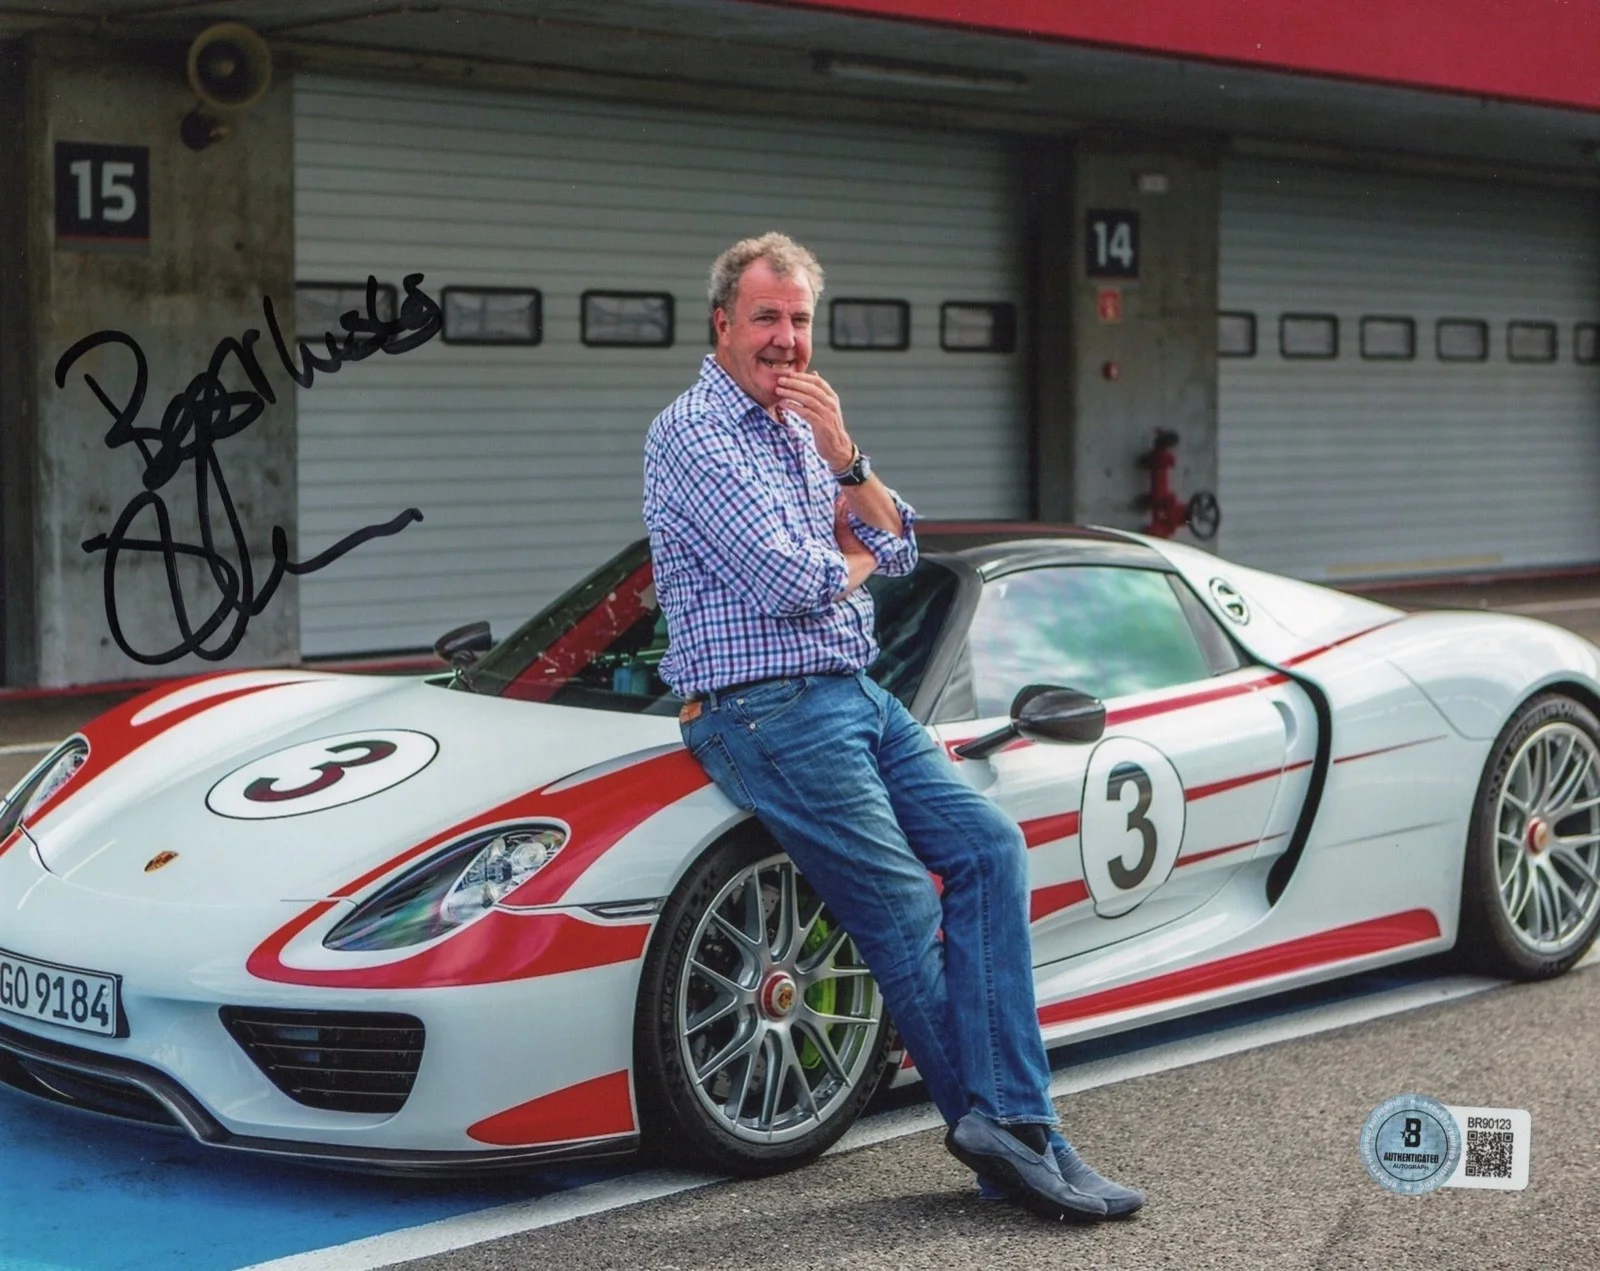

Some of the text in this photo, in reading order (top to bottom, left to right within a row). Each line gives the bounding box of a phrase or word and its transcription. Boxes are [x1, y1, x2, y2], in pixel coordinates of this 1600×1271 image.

[69, 160, 136, 222] 15
[1093, 221, 1134, 268] 14
[243, 740, 398, 802] 3
[1106, 761, 1158, 890] 3
[0, 962, 109, 1027] GO 9184
[661, 912, 693, 1023] MICHELIN
[1468, 1117, 1512, 1130] BR90123
[1383, 1152, 1439, 1164] AUTHENTICATED
